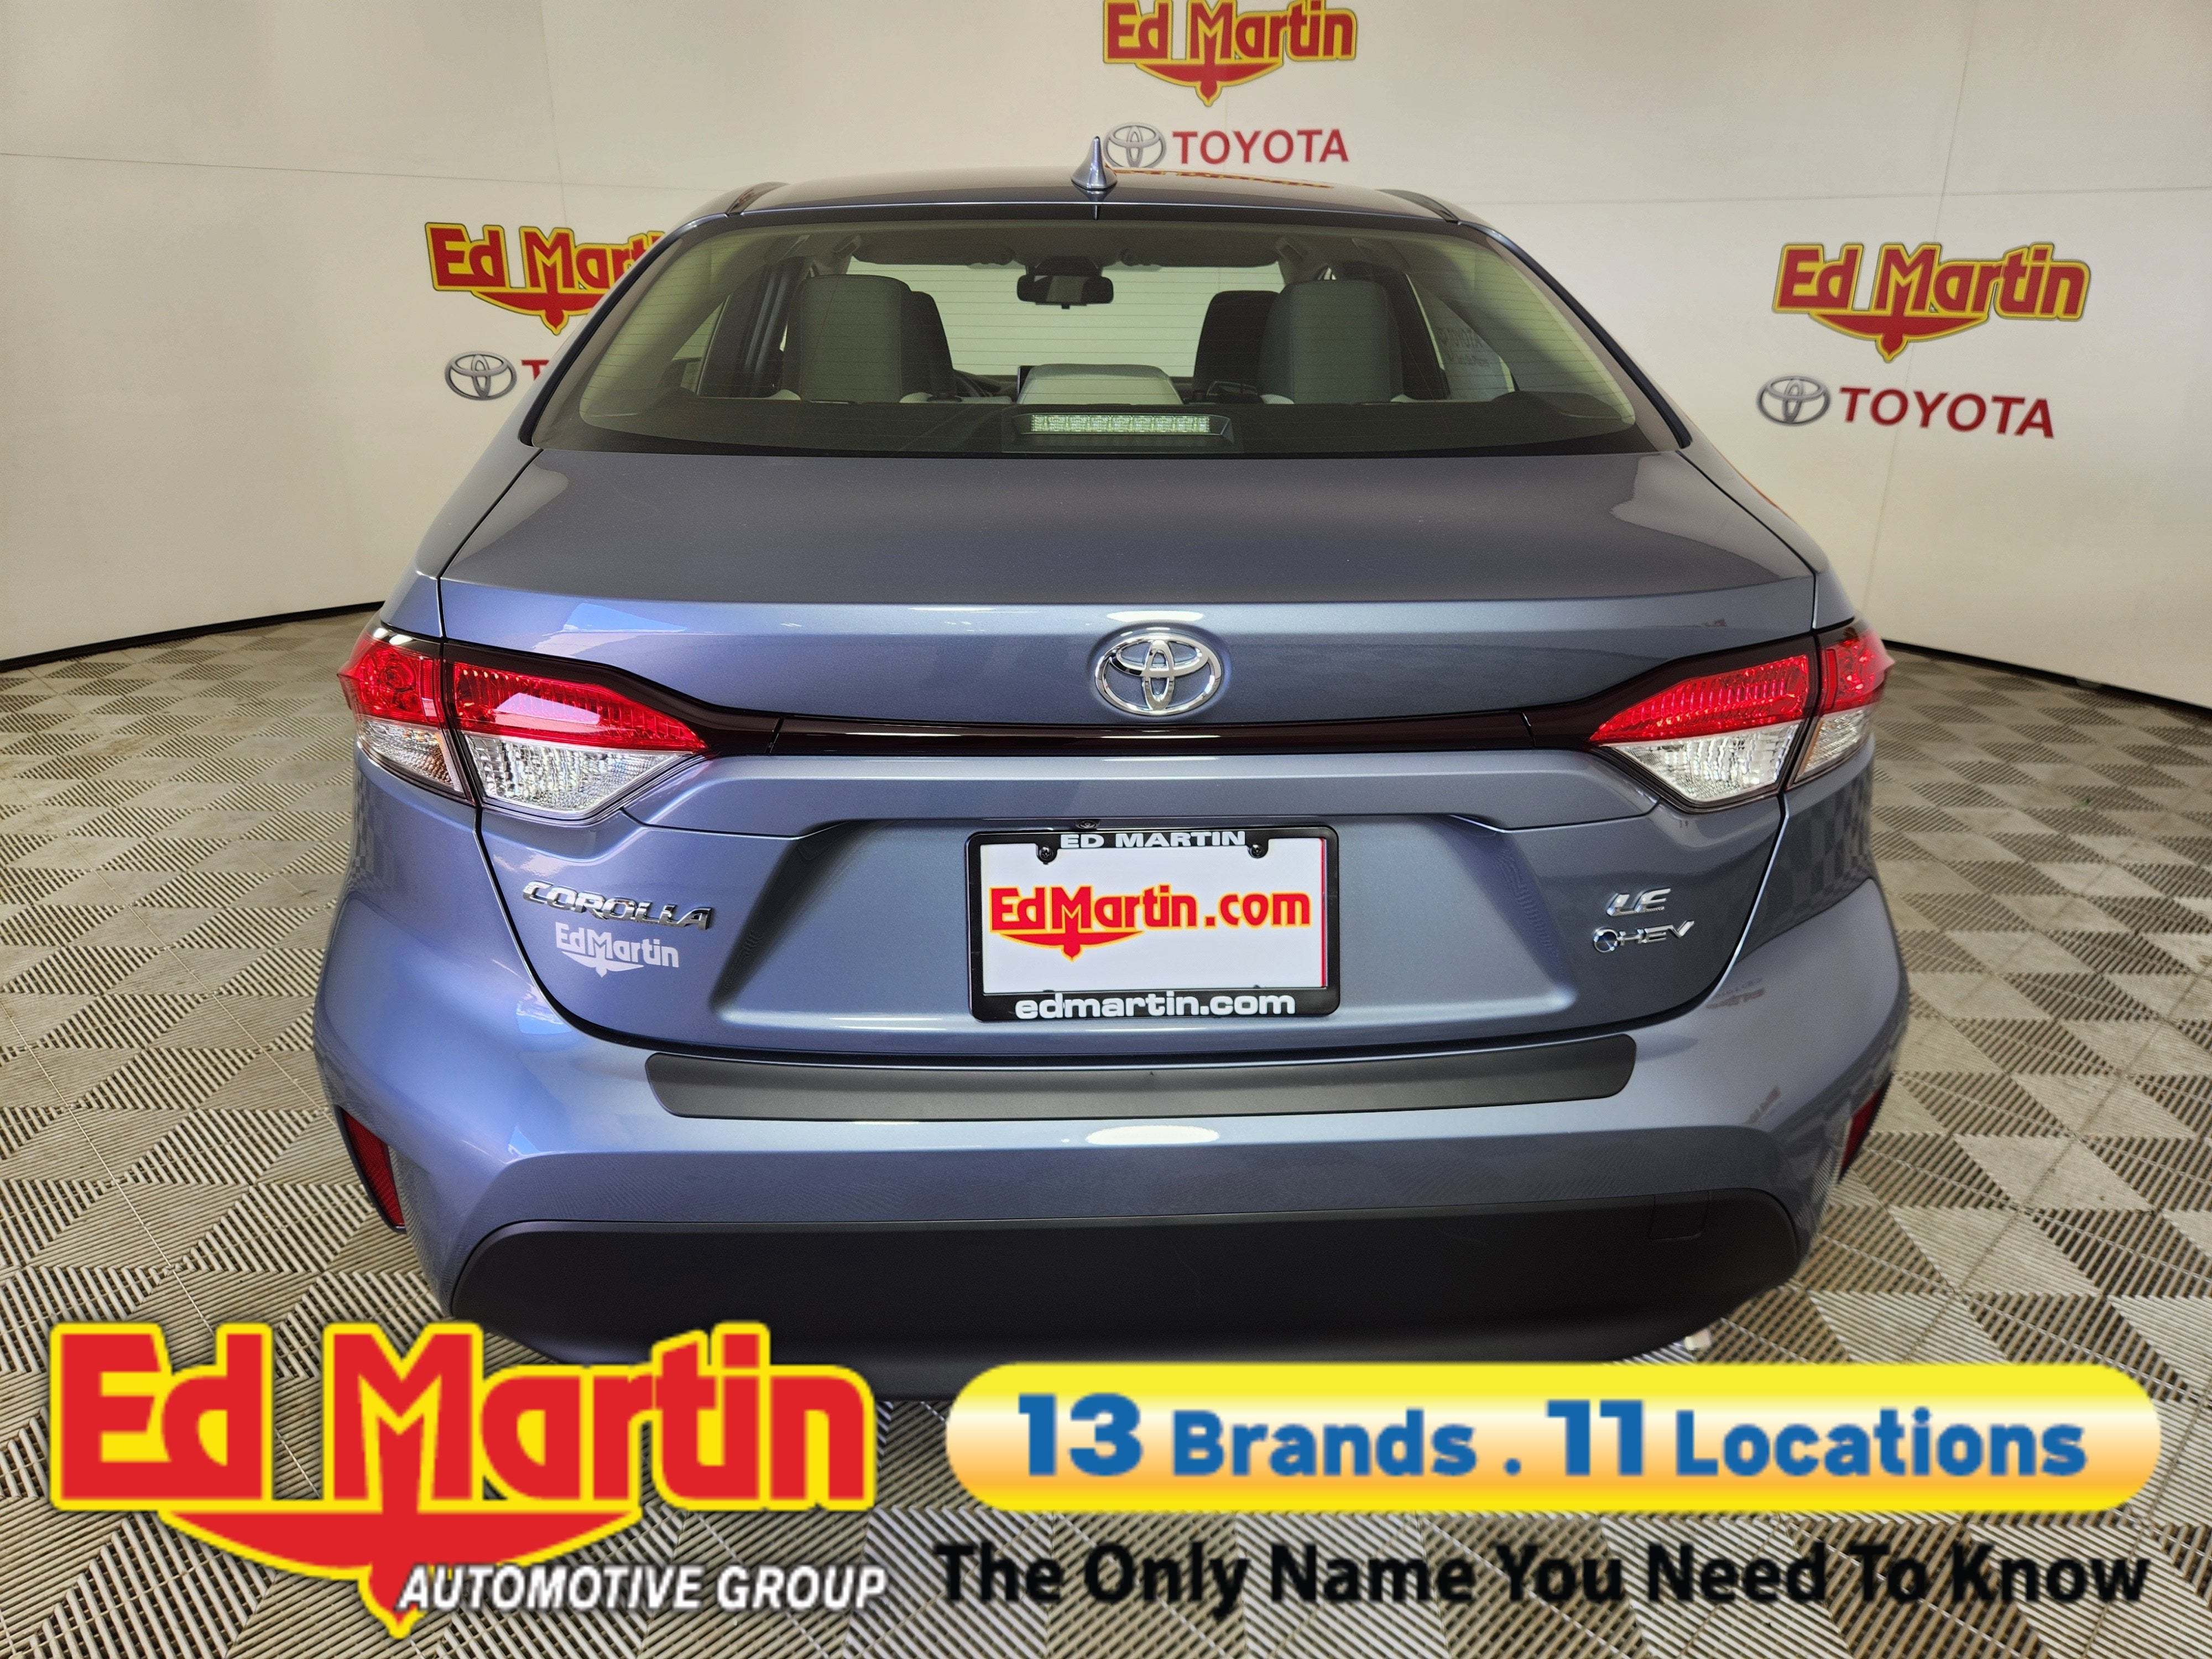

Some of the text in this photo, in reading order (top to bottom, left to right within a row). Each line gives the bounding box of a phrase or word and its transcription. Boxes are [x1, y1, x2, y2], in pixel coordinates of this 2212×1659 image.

[1105, 0, 1357, 62] Ed Martin
[1172, 129, 1349, 164] TOYOTA
[427, 223, 665, 290] Ed Mar
[1773, 243, 2090, 320] Ed Martin
[1839, 387, 2054, 439] TOYOTA
[1060, 831, 1246, 849] ED MARTIN
[523, 879, 714, 931] COROLLA
[1606, 888, 1671, 916] LE
[1015, 991, 1295, 1020] edmartin.com
